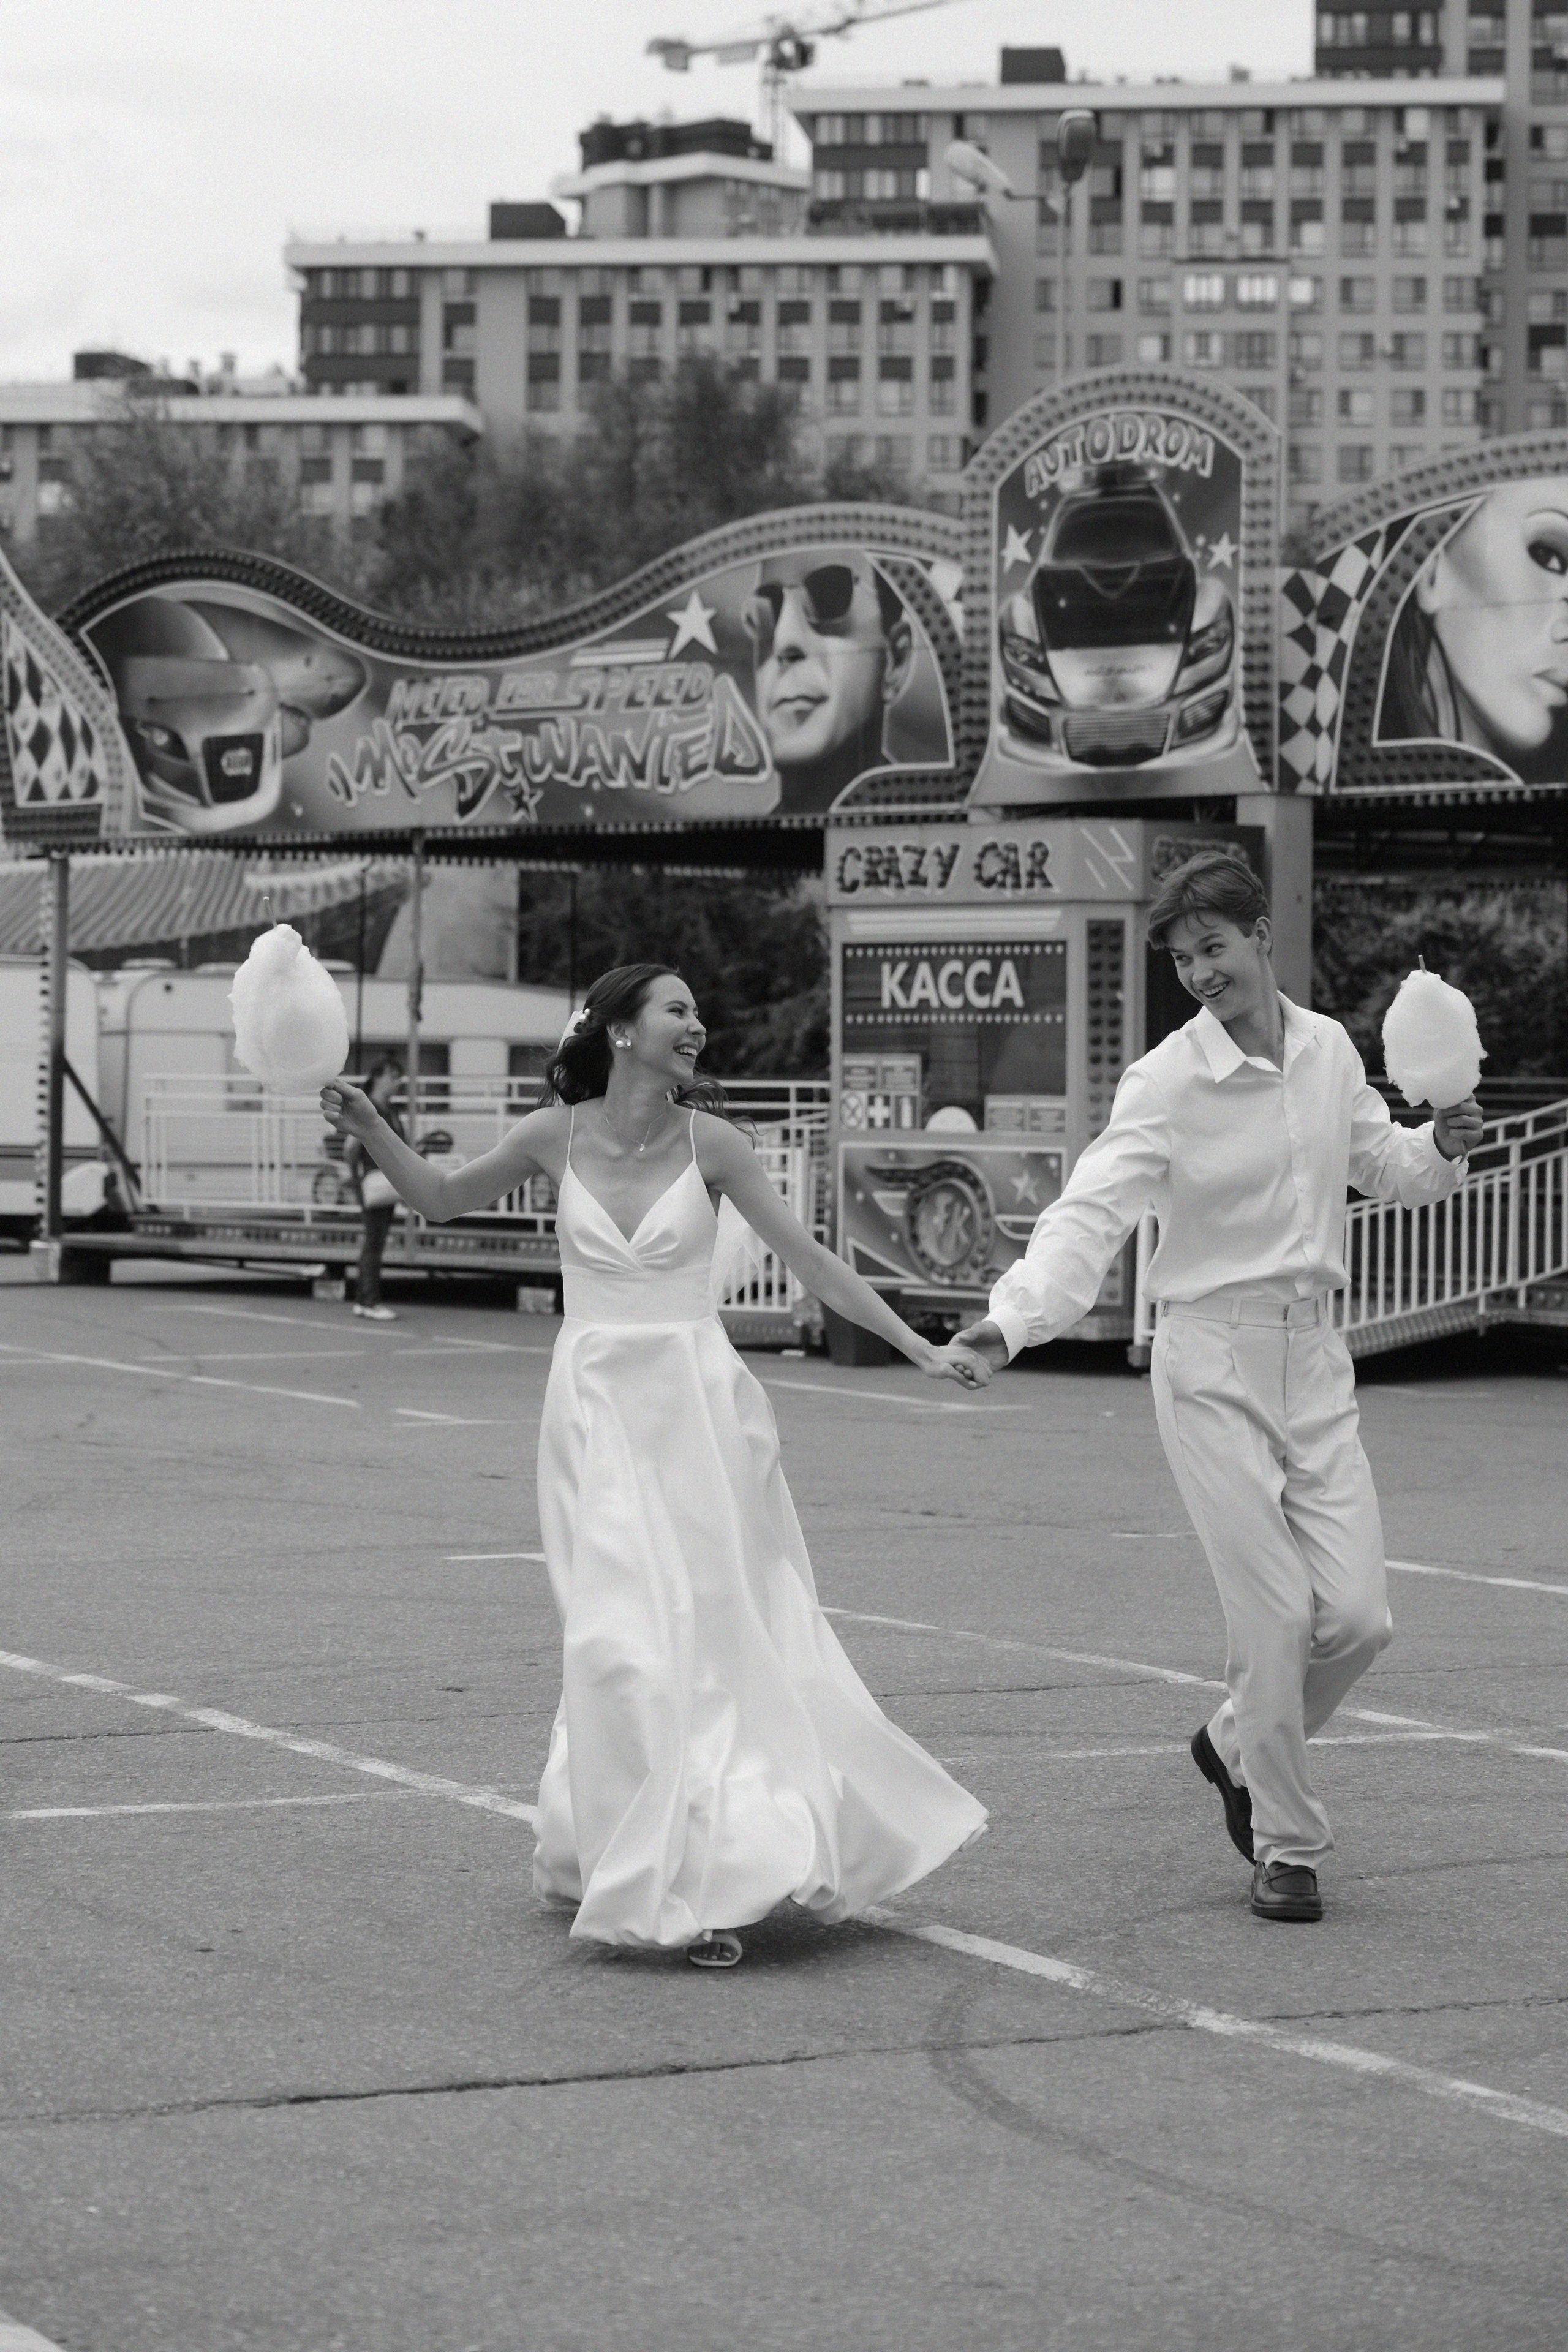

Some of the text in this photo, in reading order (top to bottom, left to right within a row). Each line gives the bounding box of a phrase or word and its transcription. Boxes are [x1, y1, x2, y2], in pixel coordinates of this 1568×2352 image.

[1024, 413, 1215, 499] AUTODROM
[567, 663, 714, 715] SPEED
[527, 674, 774, 794] WANTED
[837, 841, 1054, 893] CRAZY CAR
[880, 959, 1025, 1010] КАССА
